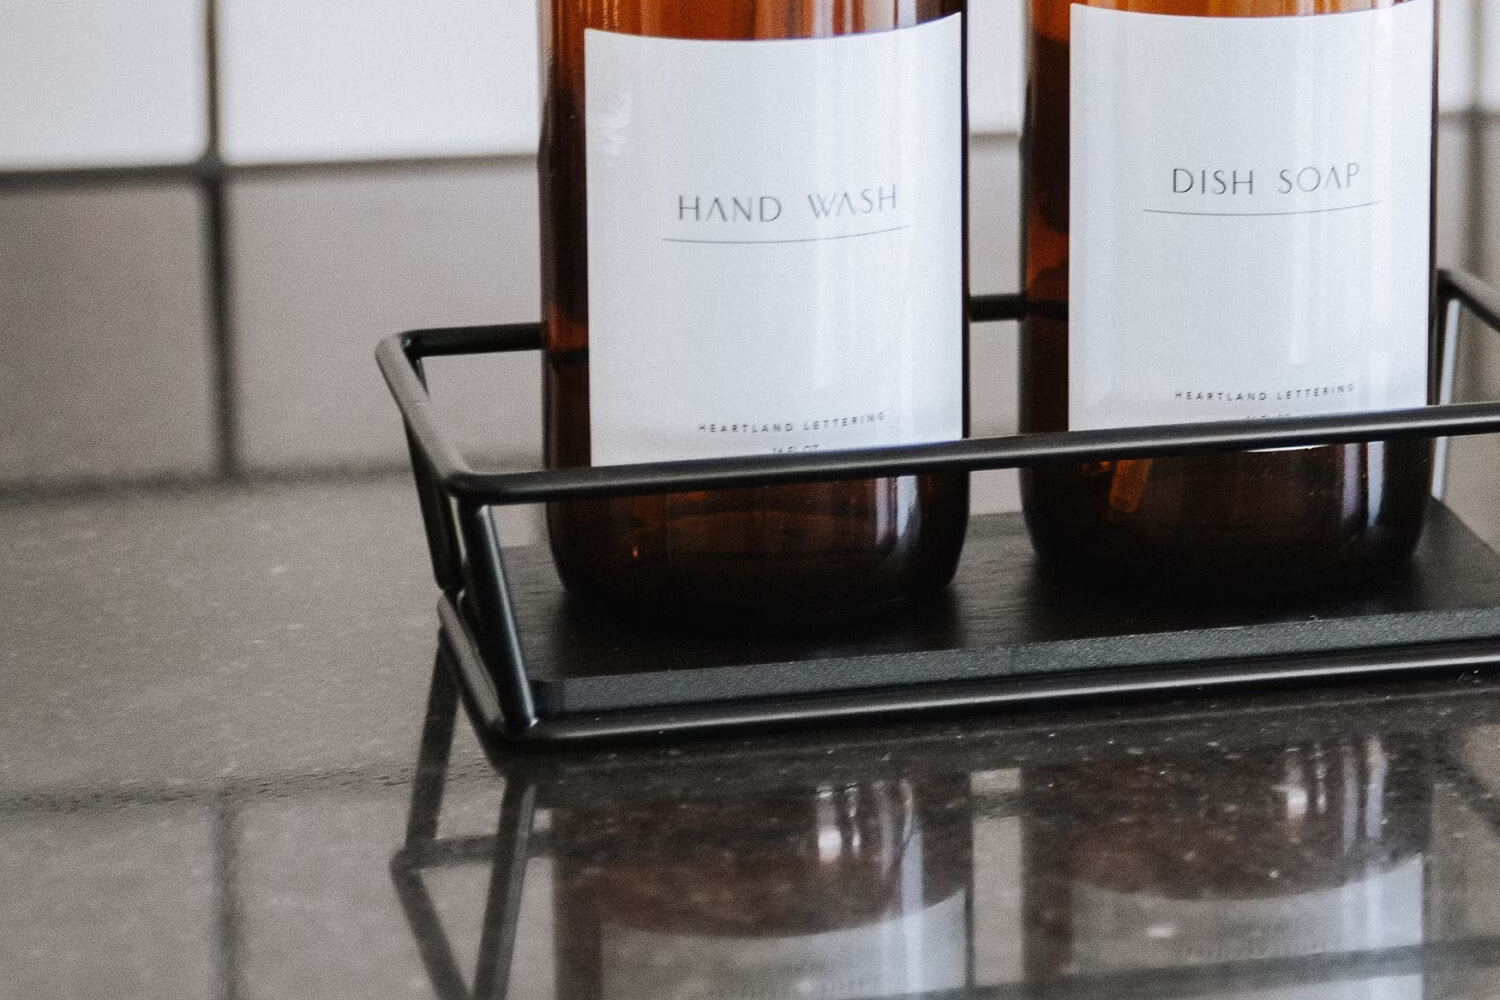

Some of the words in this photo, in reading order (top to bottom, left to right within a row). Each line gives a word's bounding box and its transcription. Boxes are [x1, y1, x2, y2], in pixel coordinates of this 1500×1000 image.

[1172, 167, 1254, 195] DISH
[1278, 162, 1360, 194] SOAP
[678, 194, 783, 223] HAND
[806, 183, 897, 219] WASH
[1175, 390, 1268, 401] HEARTLAND
[1276, 382, 1355, 400] LETTERING
[698, 422, 794, 433] HEARTLAND
[803, 411, 885, 431] LETTERING
